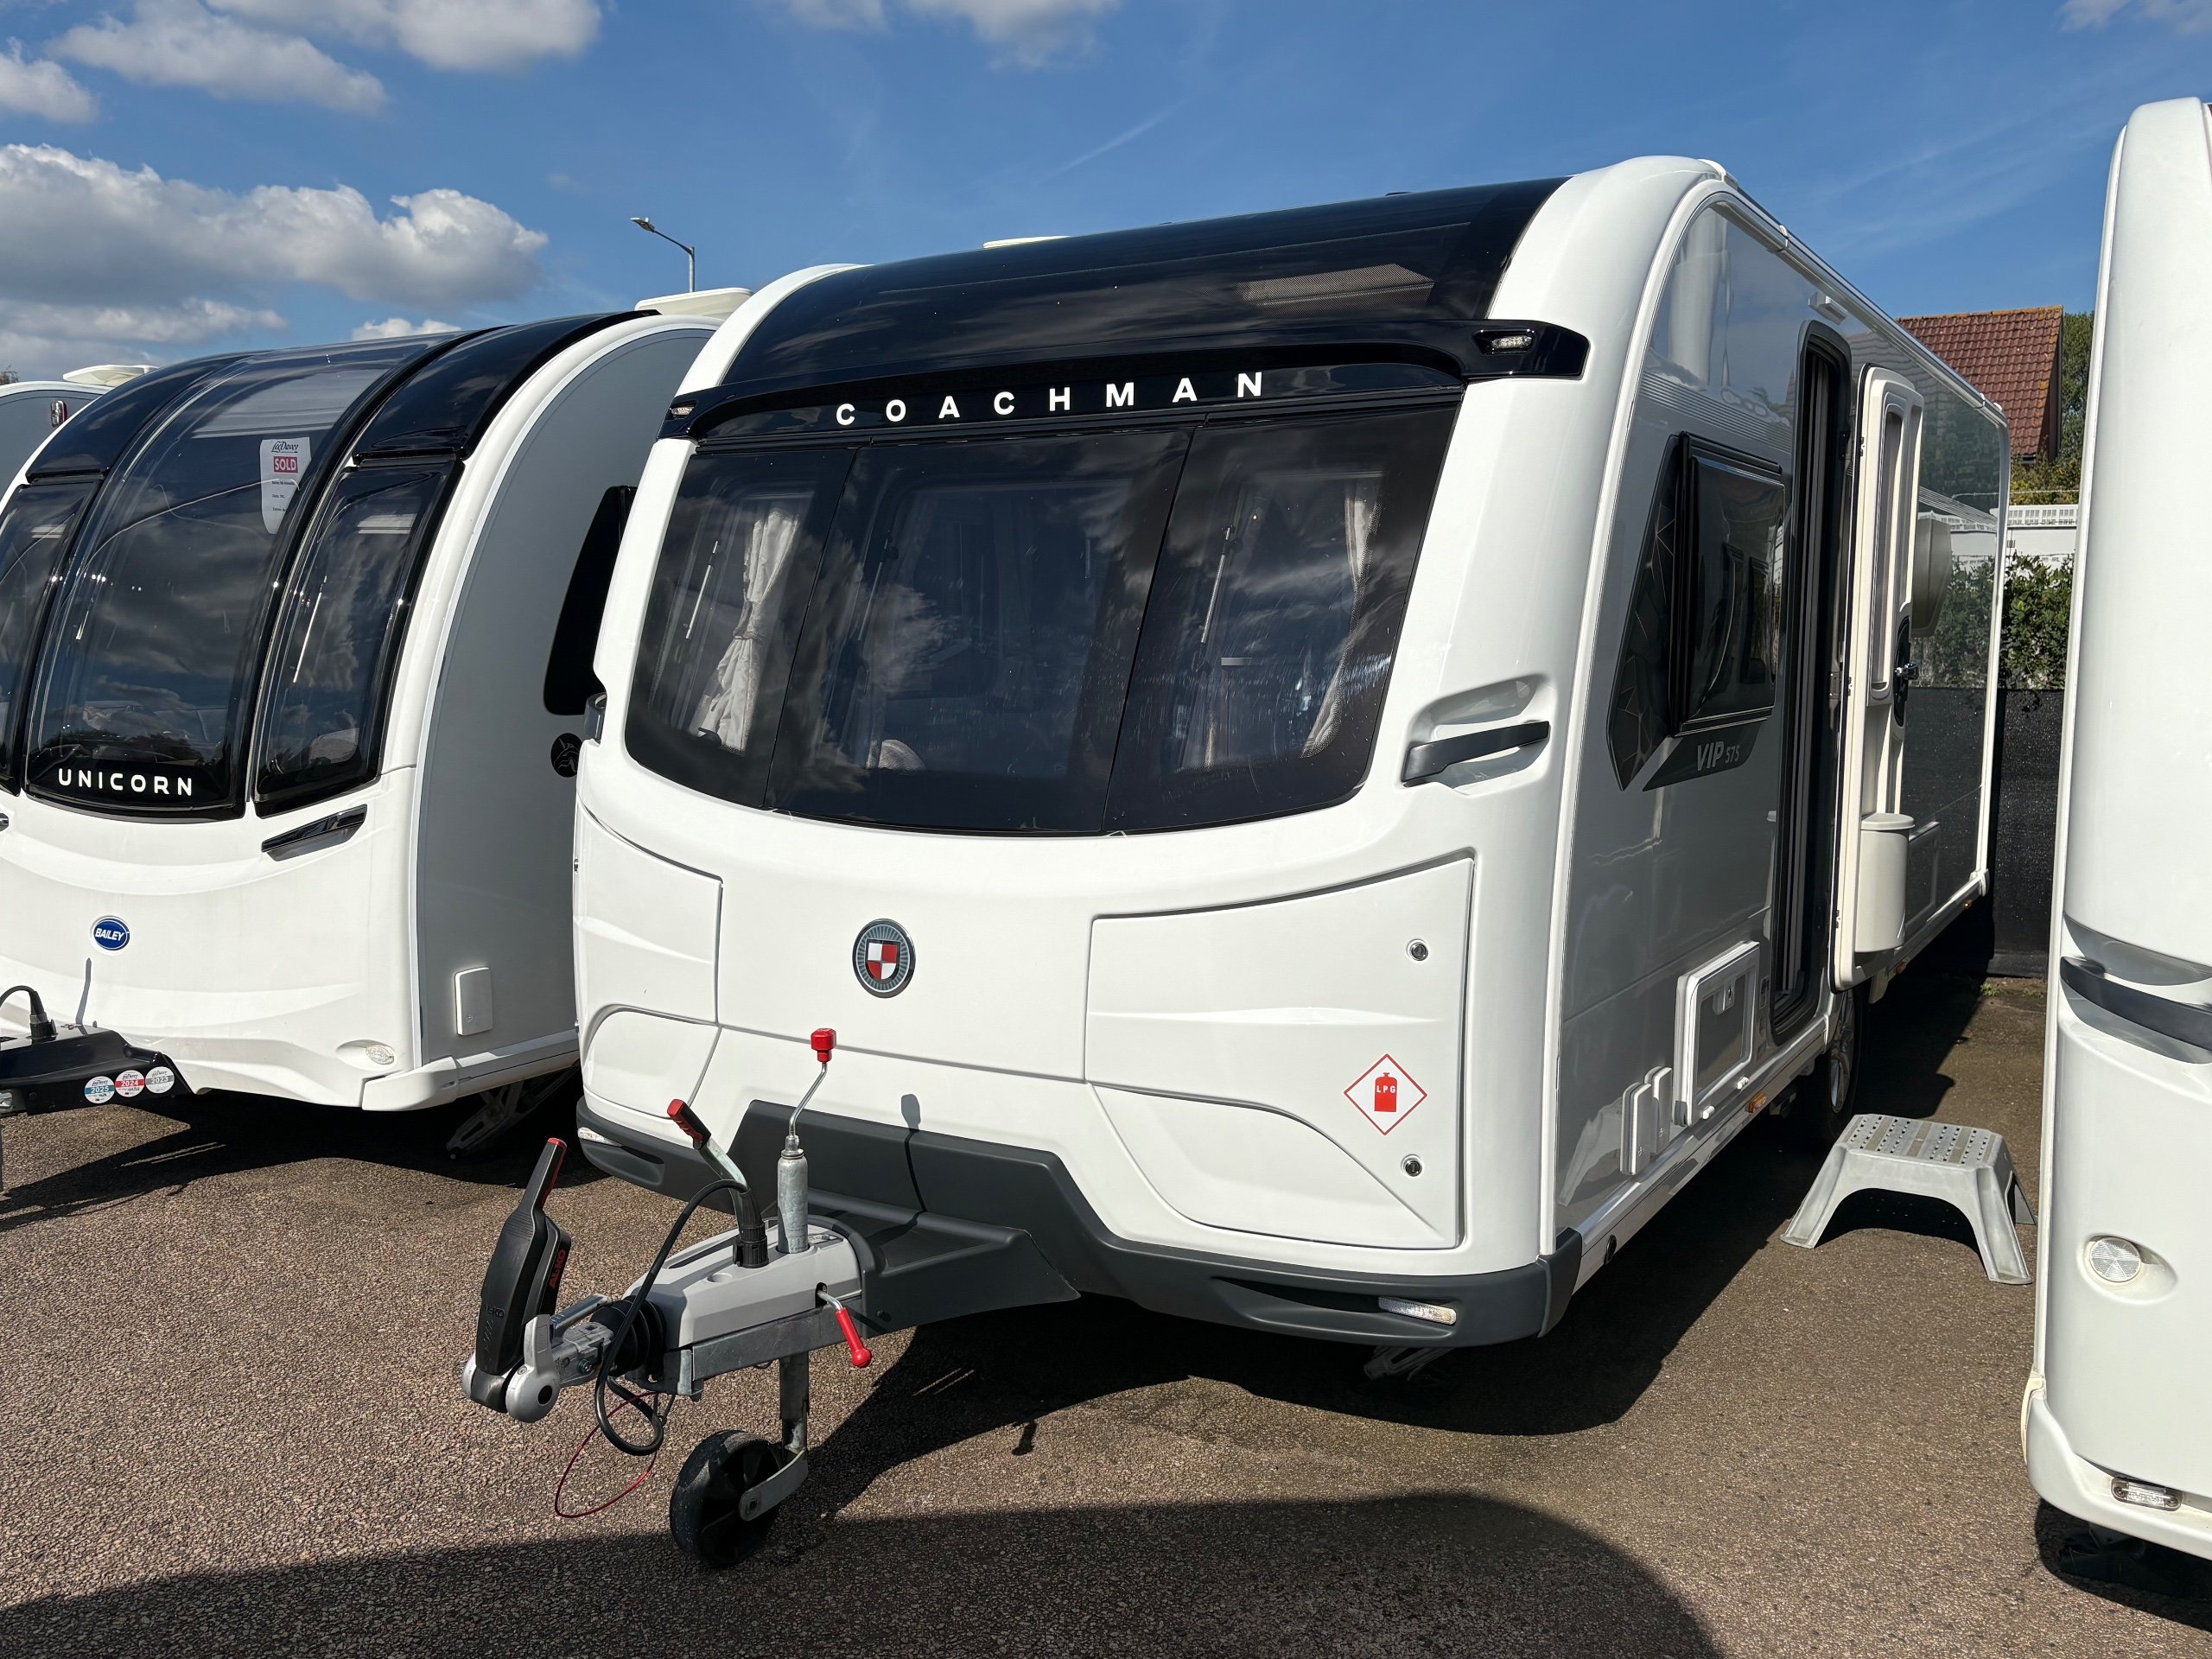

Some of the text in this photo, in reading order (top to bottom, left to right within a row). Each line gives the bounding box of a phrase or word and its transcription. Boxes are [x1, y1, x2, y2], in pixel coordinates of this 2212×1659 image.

[835, 371, 1263, 426] COACHMAN
[274, 458, 296, 471] SOLD
[1697, 741, 1740, 772] VIP 575
[58, 767, 192, 797] UNICORN
[95, 927, 124, 941] BAILEY
[1376, 1084, 1396, 1093] LPG
